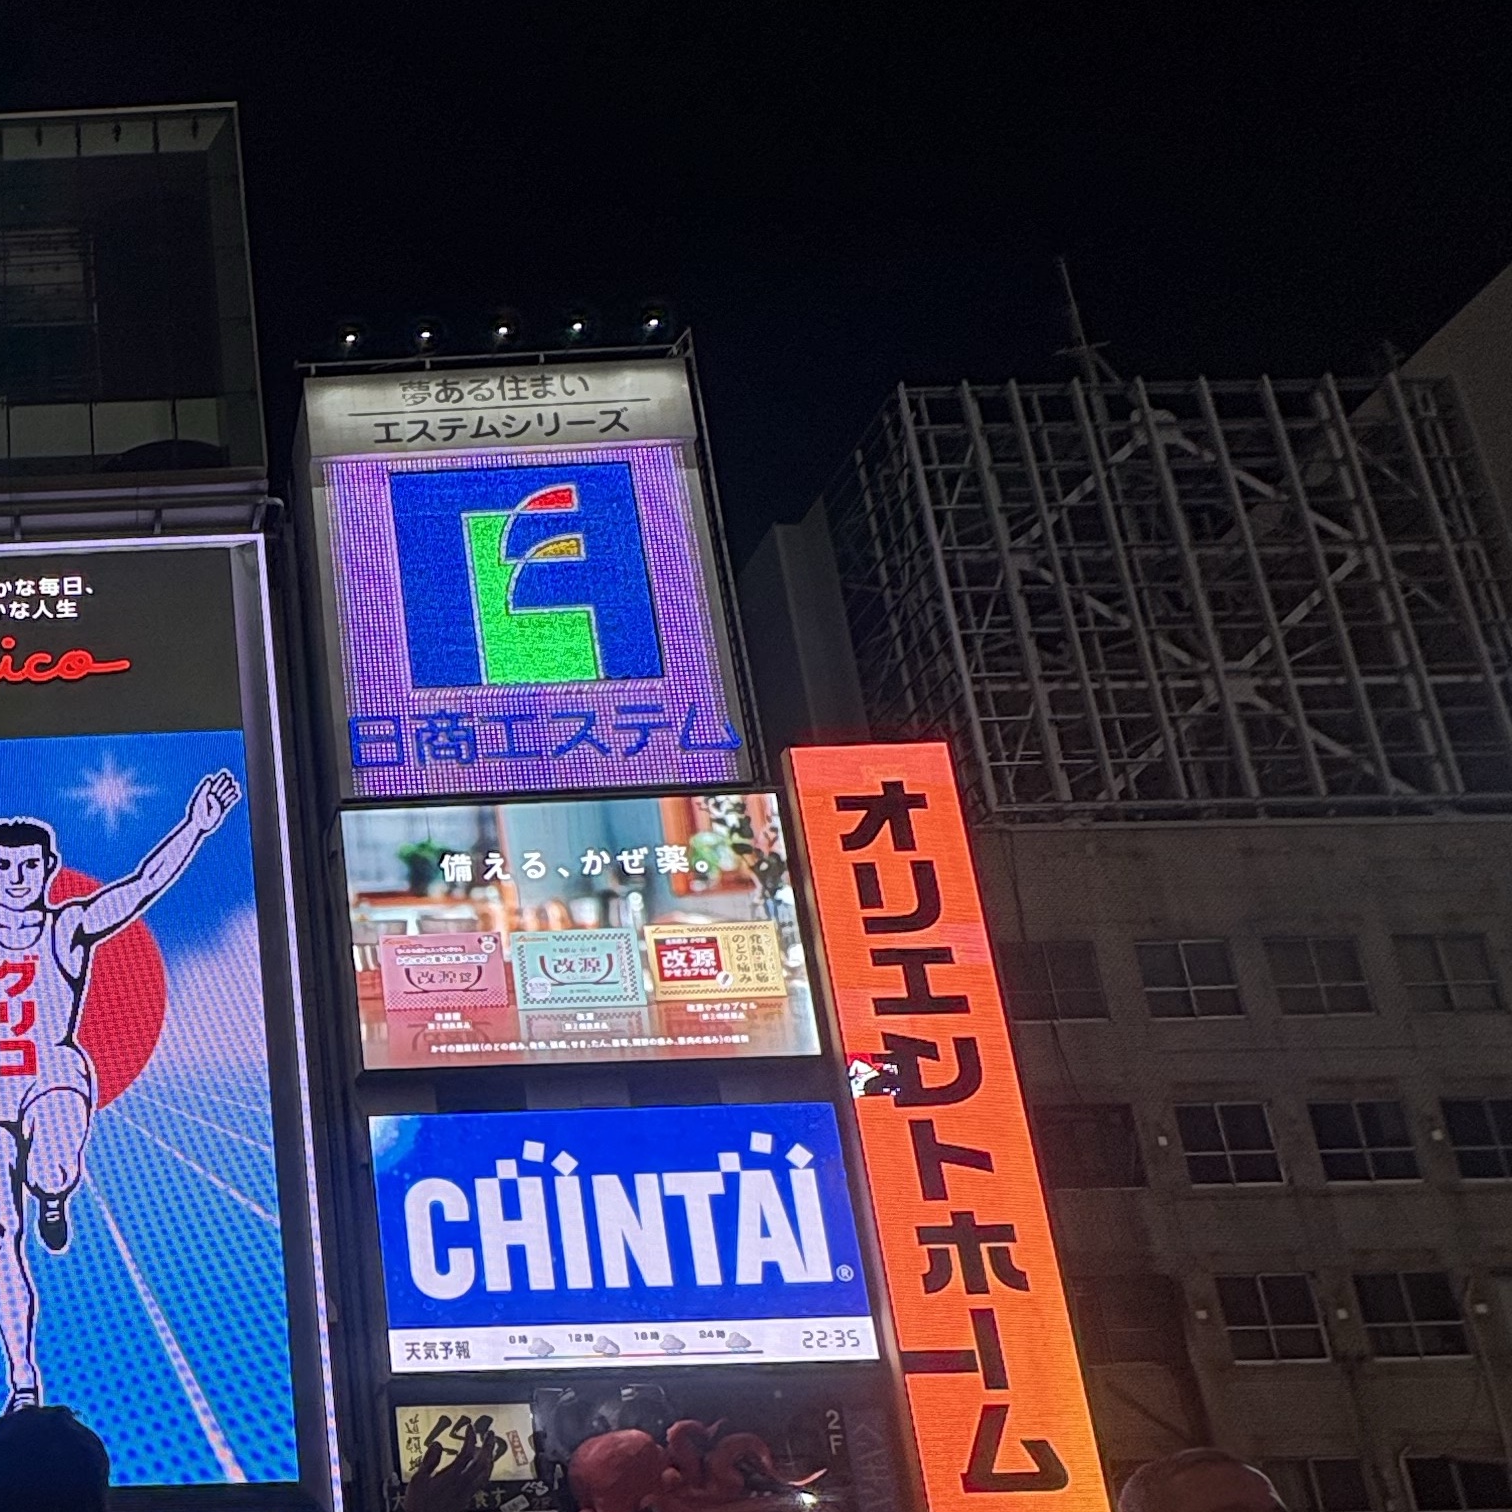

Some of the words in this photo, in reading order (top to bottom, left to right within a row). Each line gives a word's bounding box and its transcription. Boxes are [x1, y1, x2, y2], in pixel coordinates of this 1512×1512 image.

[400, 373, 590, 405] 夢ある住まい
[374, 407, 629, 445] エステムシリーズ
[348, 703, 743, 768] 日商エステム
[440, 845, 713, 883] 備える、かぜ薬。
[660, 949, 717, 968] 改源
[405, 1340, 471, 1361] 天気予報
[801, 1330, 861, 1349] 22:35
